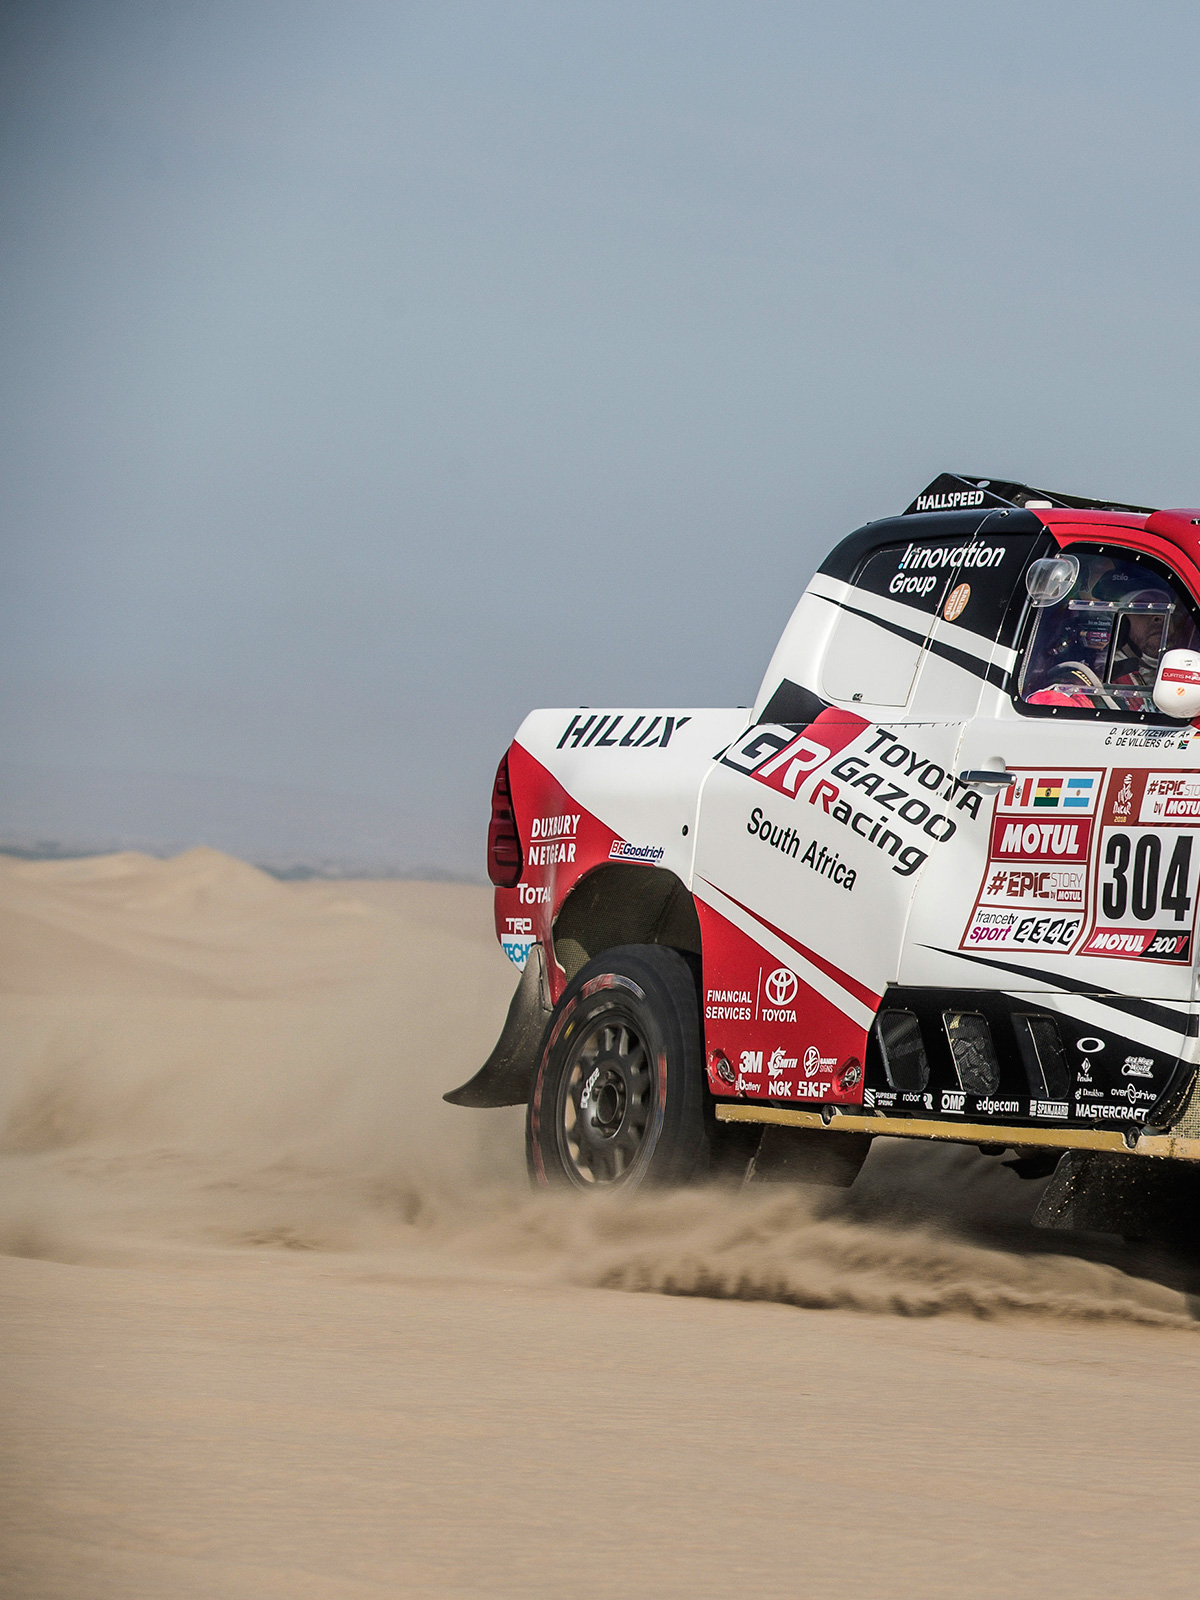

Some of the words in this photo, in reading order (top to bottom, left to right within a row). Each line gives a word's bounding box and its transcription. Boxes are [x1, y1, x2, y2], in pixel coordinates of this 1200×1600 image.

[916, 490, 984, 511] HALLSPEED
[889, 572, 938, 597] Group
[556, 715, 692, 749] HILUX
[1121, 728, 1138, 737] VON
[1116, 737, 1127, 746] DE
[1128, 738, 1161, 748] VILLIERS
[864, 728, 984, 820] TOYOTA
[830, 756, 958, 843] GAZOO
[1153, 801, 1163, 815] by
[531, 814, 581, 837] DUXBURY
[809, 778, 929, 877] Racing
[1000, 823, 1080, 855] MOTUL
[528, 843, 577, 866] NETGEAR
[747, 807, 801, 858] South
[801, 840, 858, 891] Africa
[1103, 832, 1194, 921] 304
[1057, 891, 1081, 900] MOTUL
[505, 918, 532, 934] TRD
[970, 925, 1012, 943] sport
[1088, 933, 1145, 952] MOTUL
[1147, 936, 1189, 954] 300V
[706, 990, 752, 1003] FINANCIAL
[705, 1006, 751, 1021] SERVICES
[762, 1009, 797, 1023] TOYOTA
[739, 1050, 763, 1073] 3M
[768, 1081, 792, 1097] NGK
[797, 1081, 831, 1097] SKF
[941, 1094, 965, 1111] OMP
[976, 1096, 1019, 1114] edgecam
[1075, 1103, 1150, 1121] MASTERCRAFT
